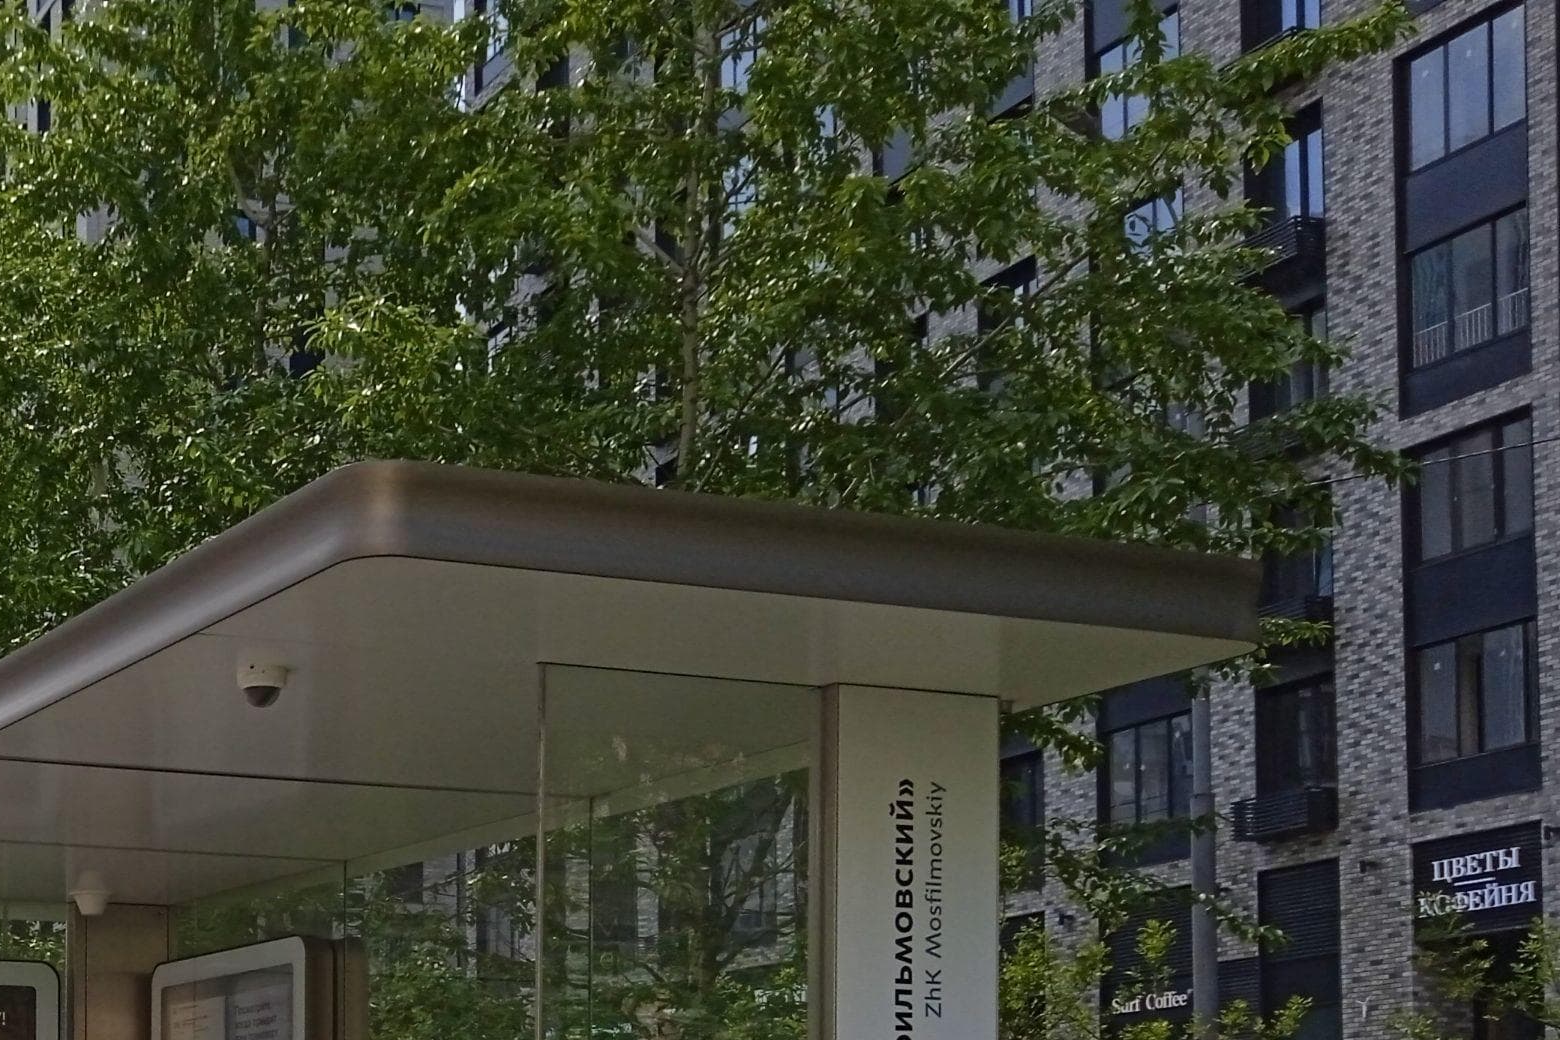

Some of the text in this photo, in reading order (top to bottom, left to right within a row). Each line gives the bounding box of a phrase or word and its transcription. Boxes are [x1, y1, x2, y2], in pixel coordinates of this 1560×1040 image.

[924, 781, 947, 1018] ZhK Mosfilmovskiy
[1431, 846, 1521, 883] ЦВЕТЫ
